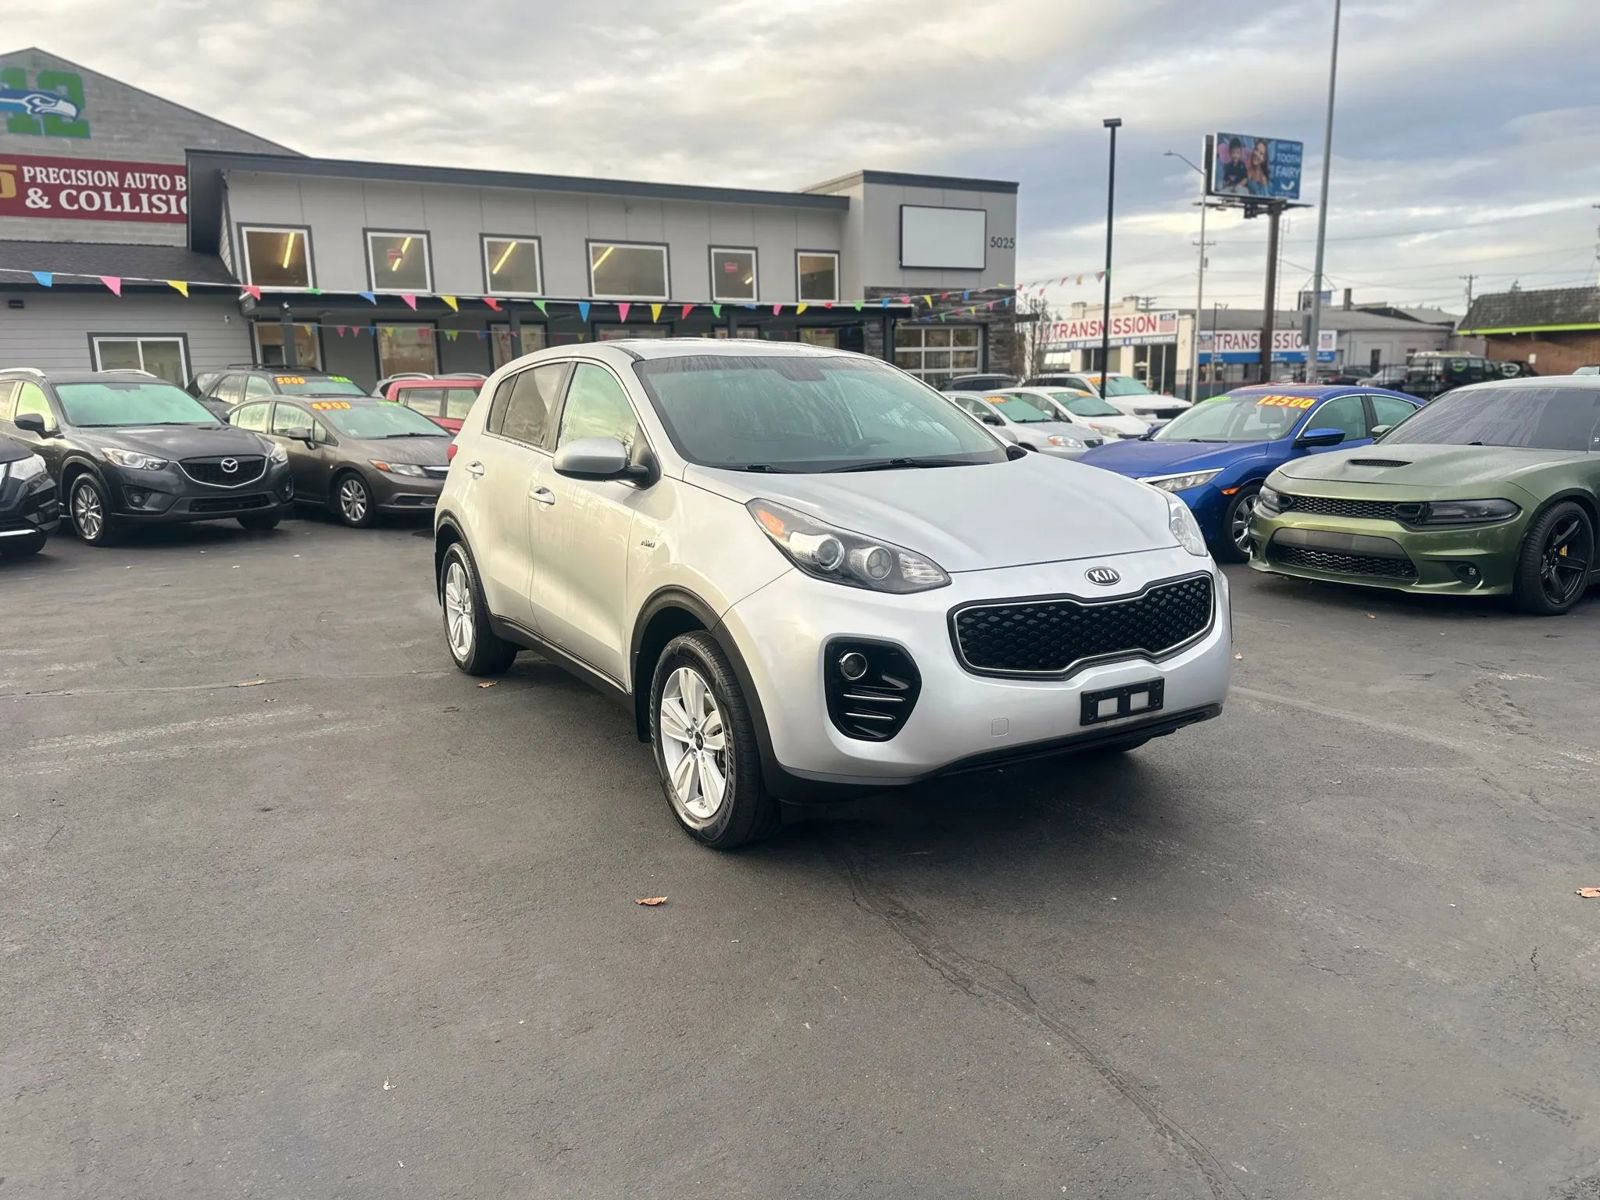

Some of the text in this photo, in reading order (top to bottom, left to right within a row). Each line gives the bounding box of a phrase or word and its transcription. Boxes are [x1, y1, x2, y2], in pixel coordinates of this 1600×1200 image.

[22, 166, 120, 188] PRECISION
[124, 172, 171, 191] AUTO
[25, 188, 52, 210] &
[990, 236, 1016, 250] 5025
[1258, 395, 1316, 408] 12500
[1090, 568, 1119, 583] KIA
